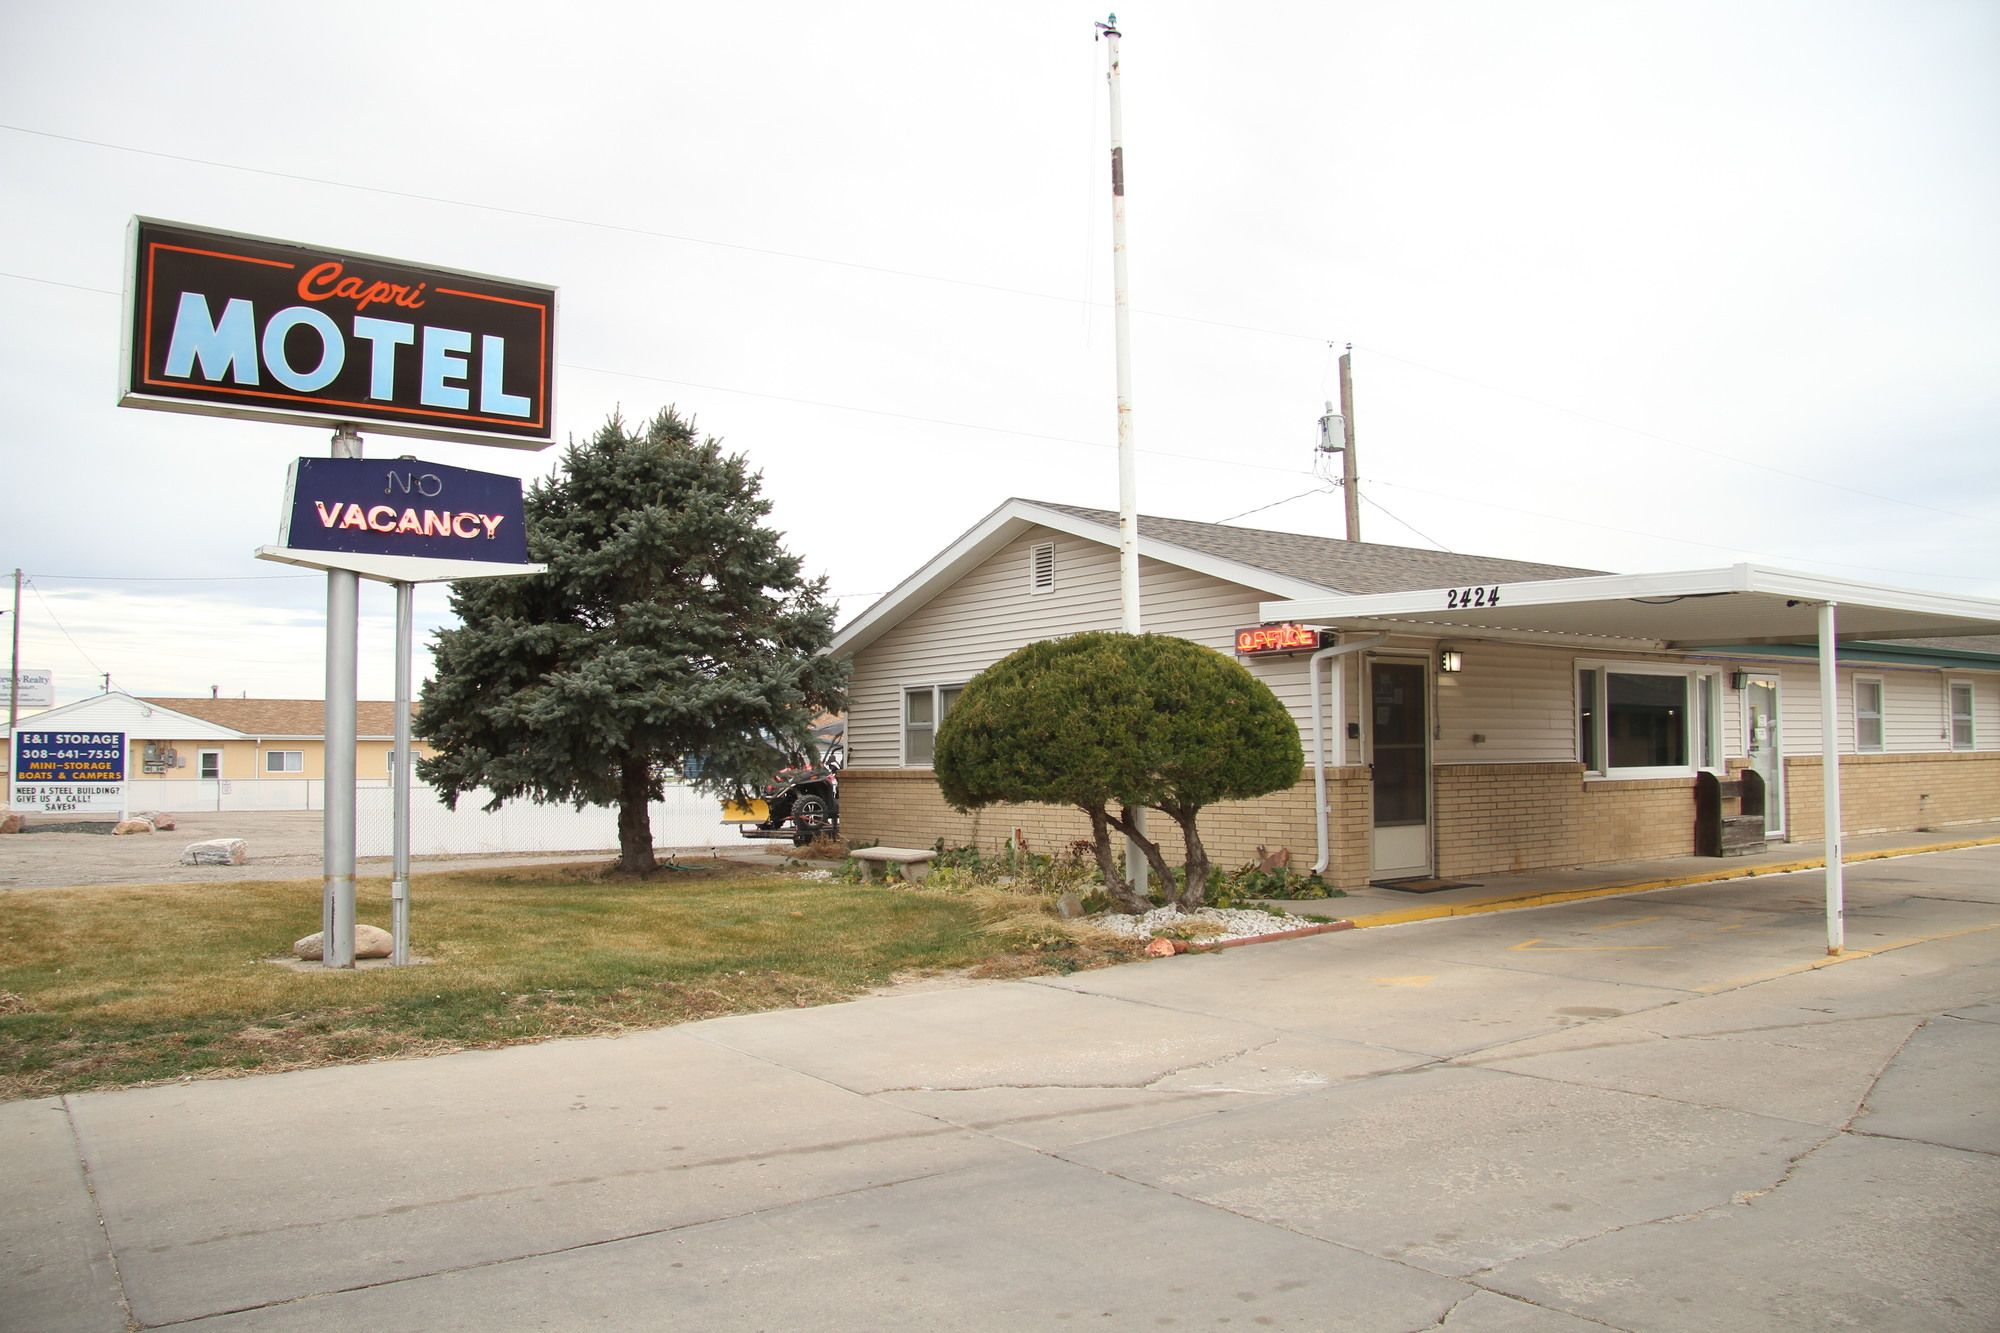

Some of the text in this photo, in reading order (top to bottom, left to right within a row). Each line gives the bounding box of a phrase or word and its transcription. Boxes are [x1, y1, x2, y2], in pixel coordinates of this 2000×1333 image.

[297, 262, 427, 311] Capri
[164, 291, 532, 418] MOTEL
[385, 470, 443, 497] NO
[315, 500, 505, 540] VACANCY
[1447, 586, 1500, 609] 2424
[56, 734, 119, 744] STORAGE
[22, 749, 120, 759] 308-641-7550
[30, 762, 112, 770] MINI-STORAGE
[18, 772, 122, 780] BOATS & CAMPERS
[16, 787, 120, 795] NEED A STEEL BUILDING?
[16, 795, 36, 803] GIVE
[40, 795, 50, 803] US
[56, 795, 61, 803] A
